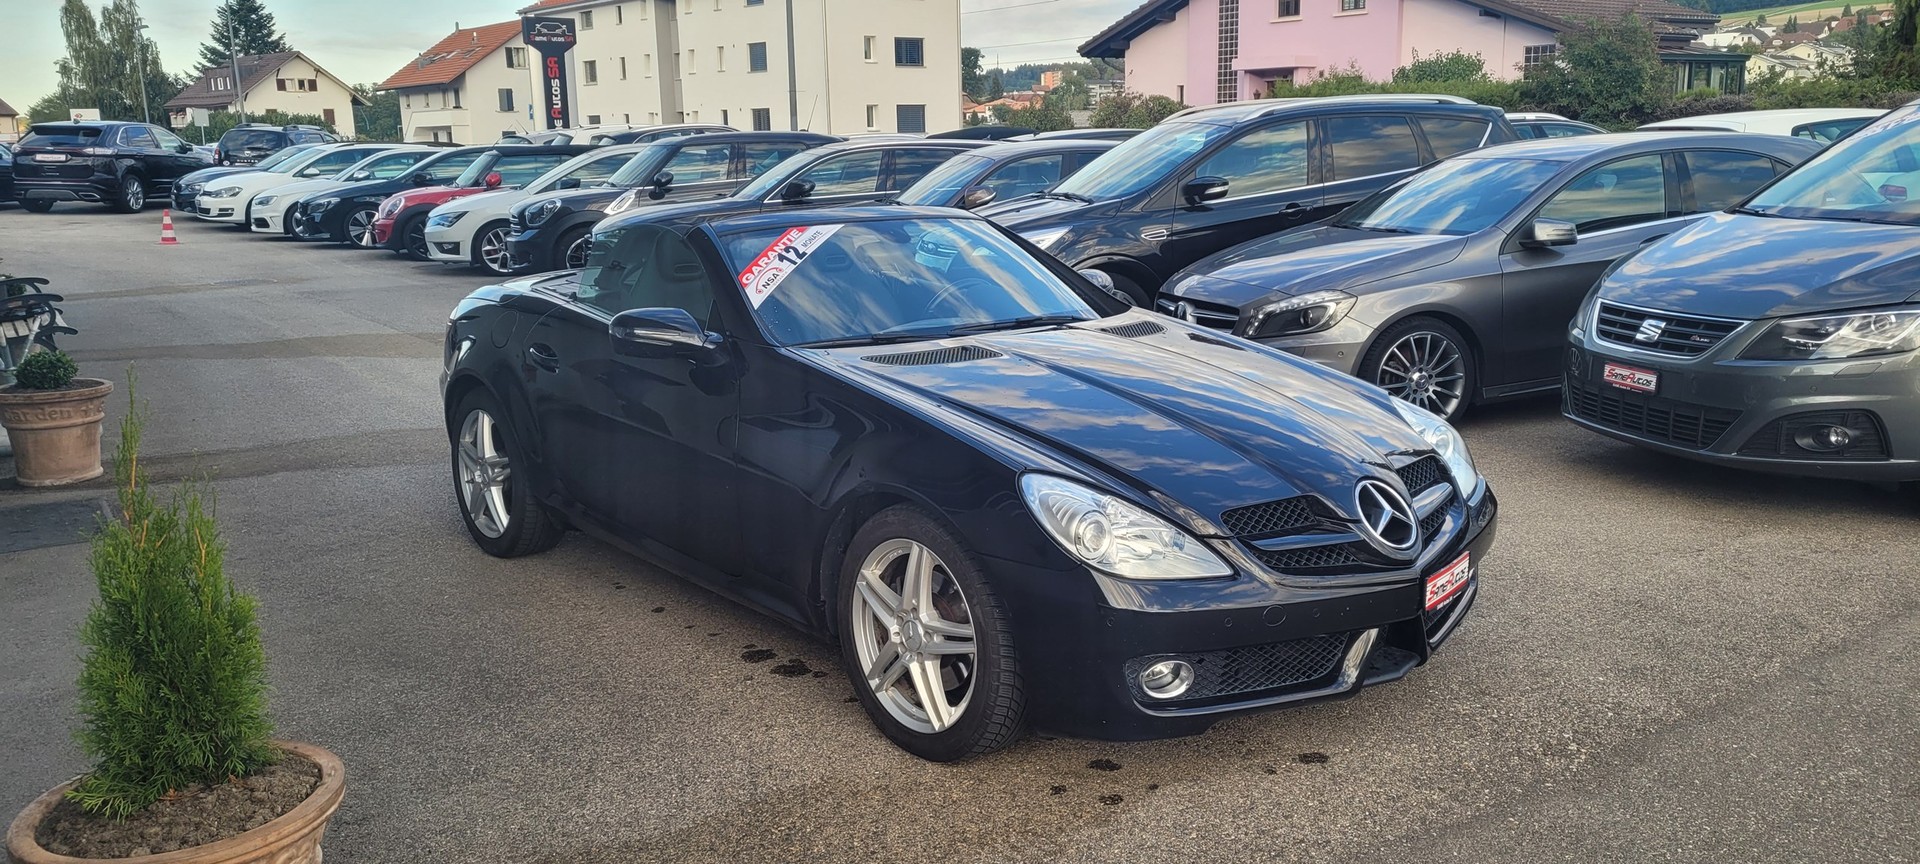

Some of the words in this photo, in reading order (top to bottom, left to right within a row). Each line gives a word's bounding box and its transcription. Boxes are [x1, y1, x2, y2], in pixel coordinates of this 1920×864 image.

[742, 229, 803, 284] GARANTIE
[777, 245, 808, 266] 12
[801, 229, 823, 248] MONATE
[761, 272, 780, 289] NSA
